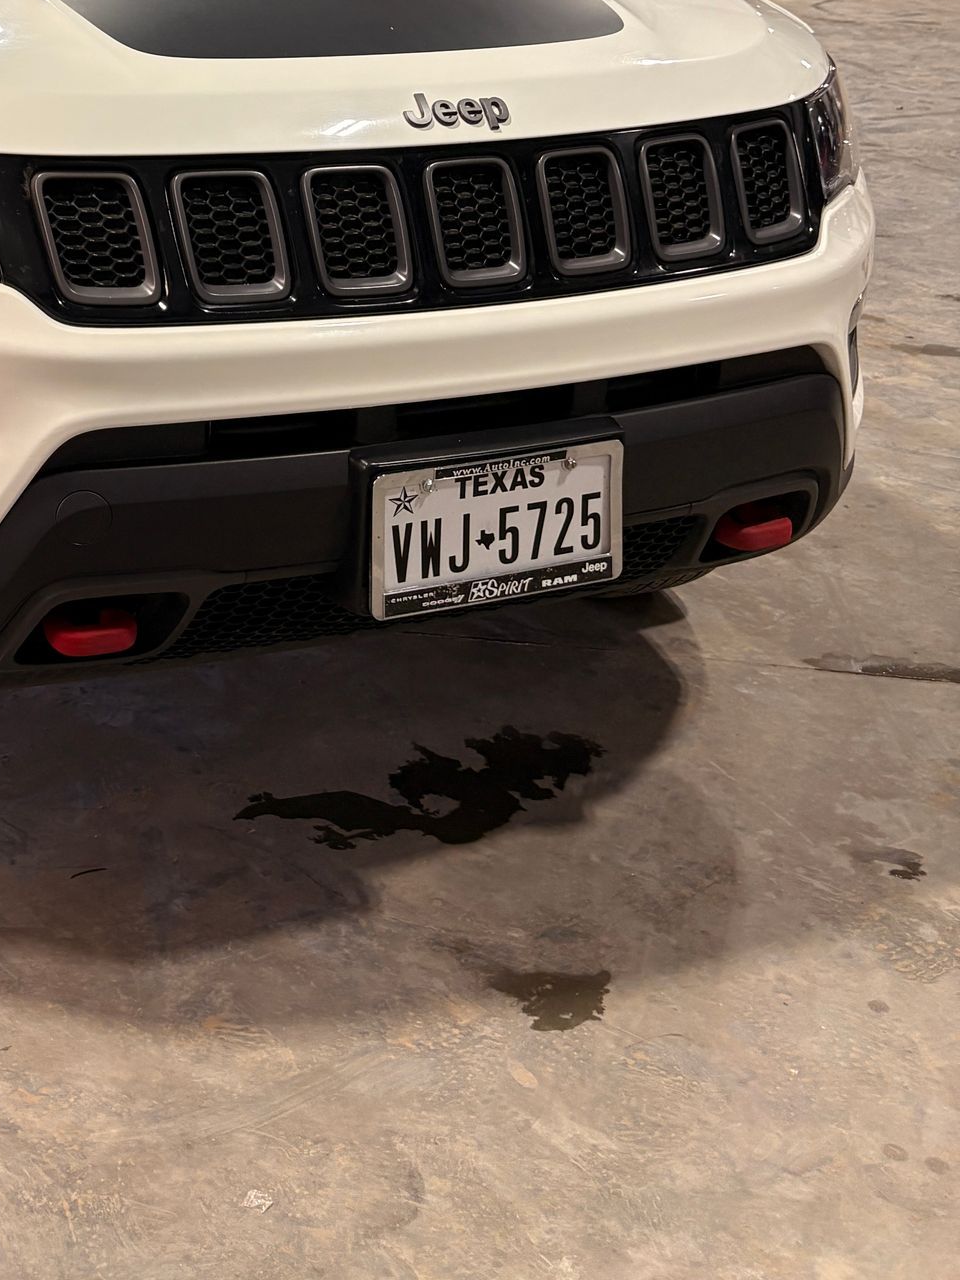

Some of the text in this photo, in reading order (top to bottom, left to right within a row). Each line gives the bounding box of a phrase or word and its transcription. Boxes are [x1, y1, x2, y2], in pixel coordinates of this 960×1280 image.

[403, 93, 510, 130] Jeep
[452, 455, 551, 477] www.AutoInc.com
[455, 465, 545, 500] TEXAS
[581, 561, 608, 574] Jeep
[542, 574, 578, 588] RAM
[391, 592, 434, 604] CHRYSLER
